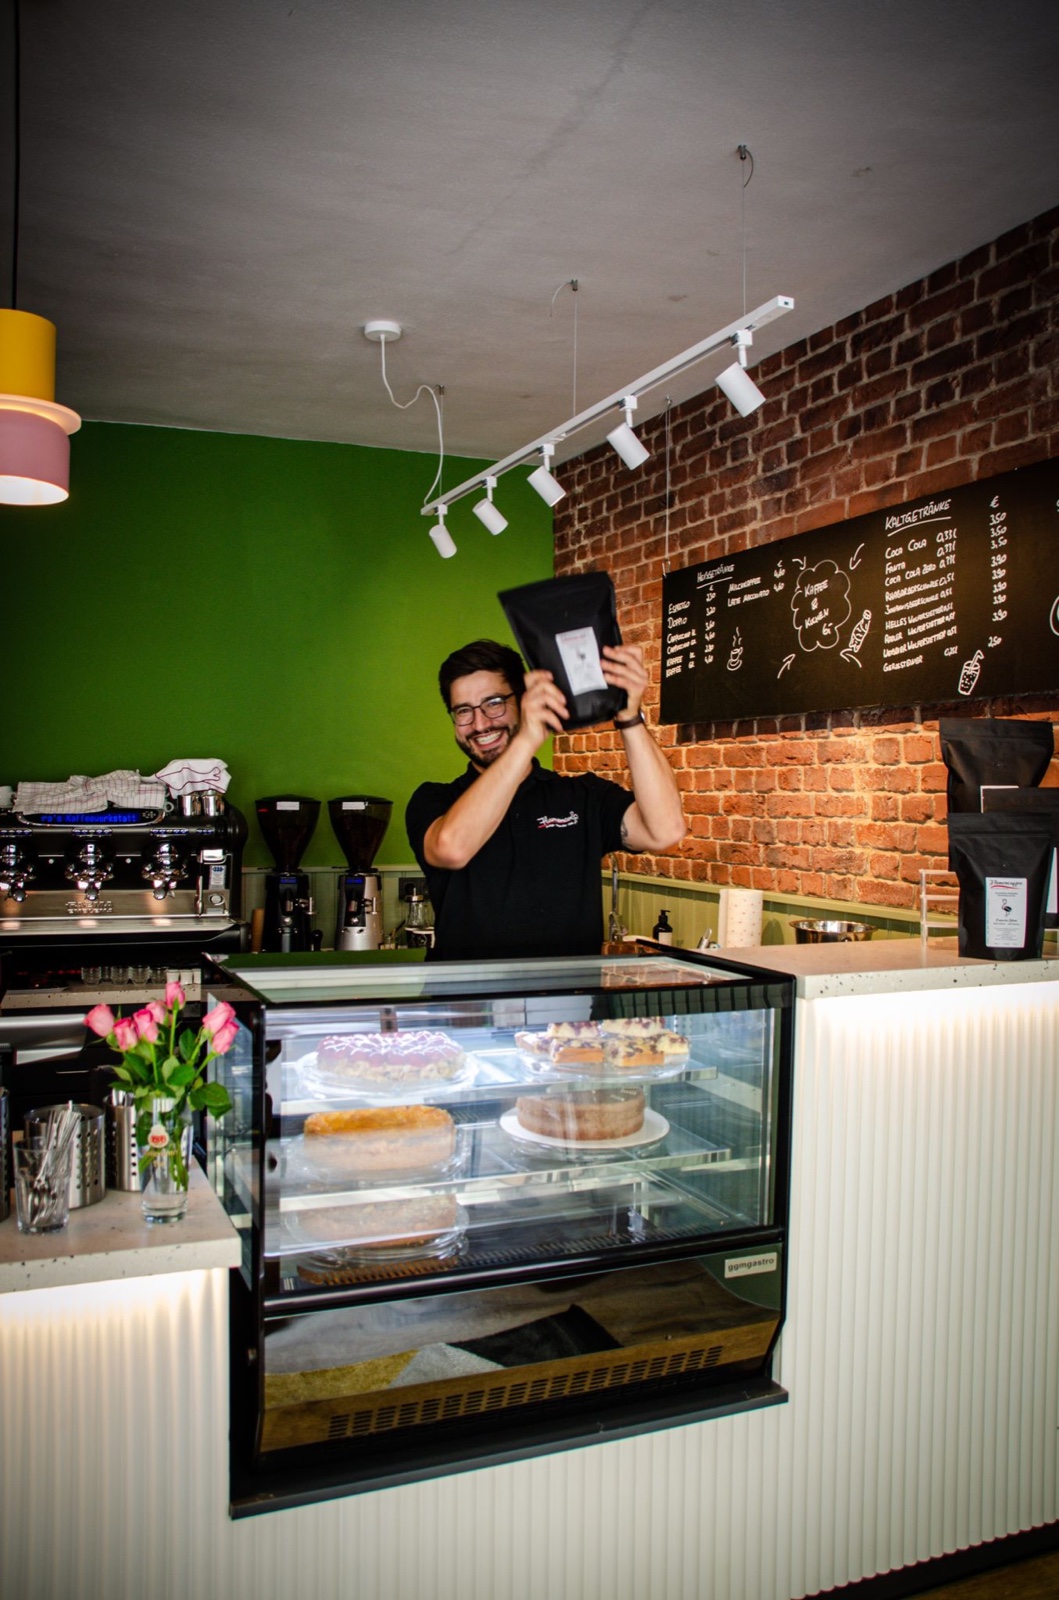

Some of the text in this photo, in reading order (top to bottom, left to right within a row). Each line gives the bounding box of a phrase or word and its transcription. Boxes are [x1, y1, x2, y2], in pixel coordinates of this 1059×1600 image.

[990, 496, 999, 508] €
[989, 512, 1007, 526] 3,50
[990, 525, 1007, 538] 3,50
[990, 536, 1008, 550] 3,50
[728, 1258, 775, 1272] ggmgastro
